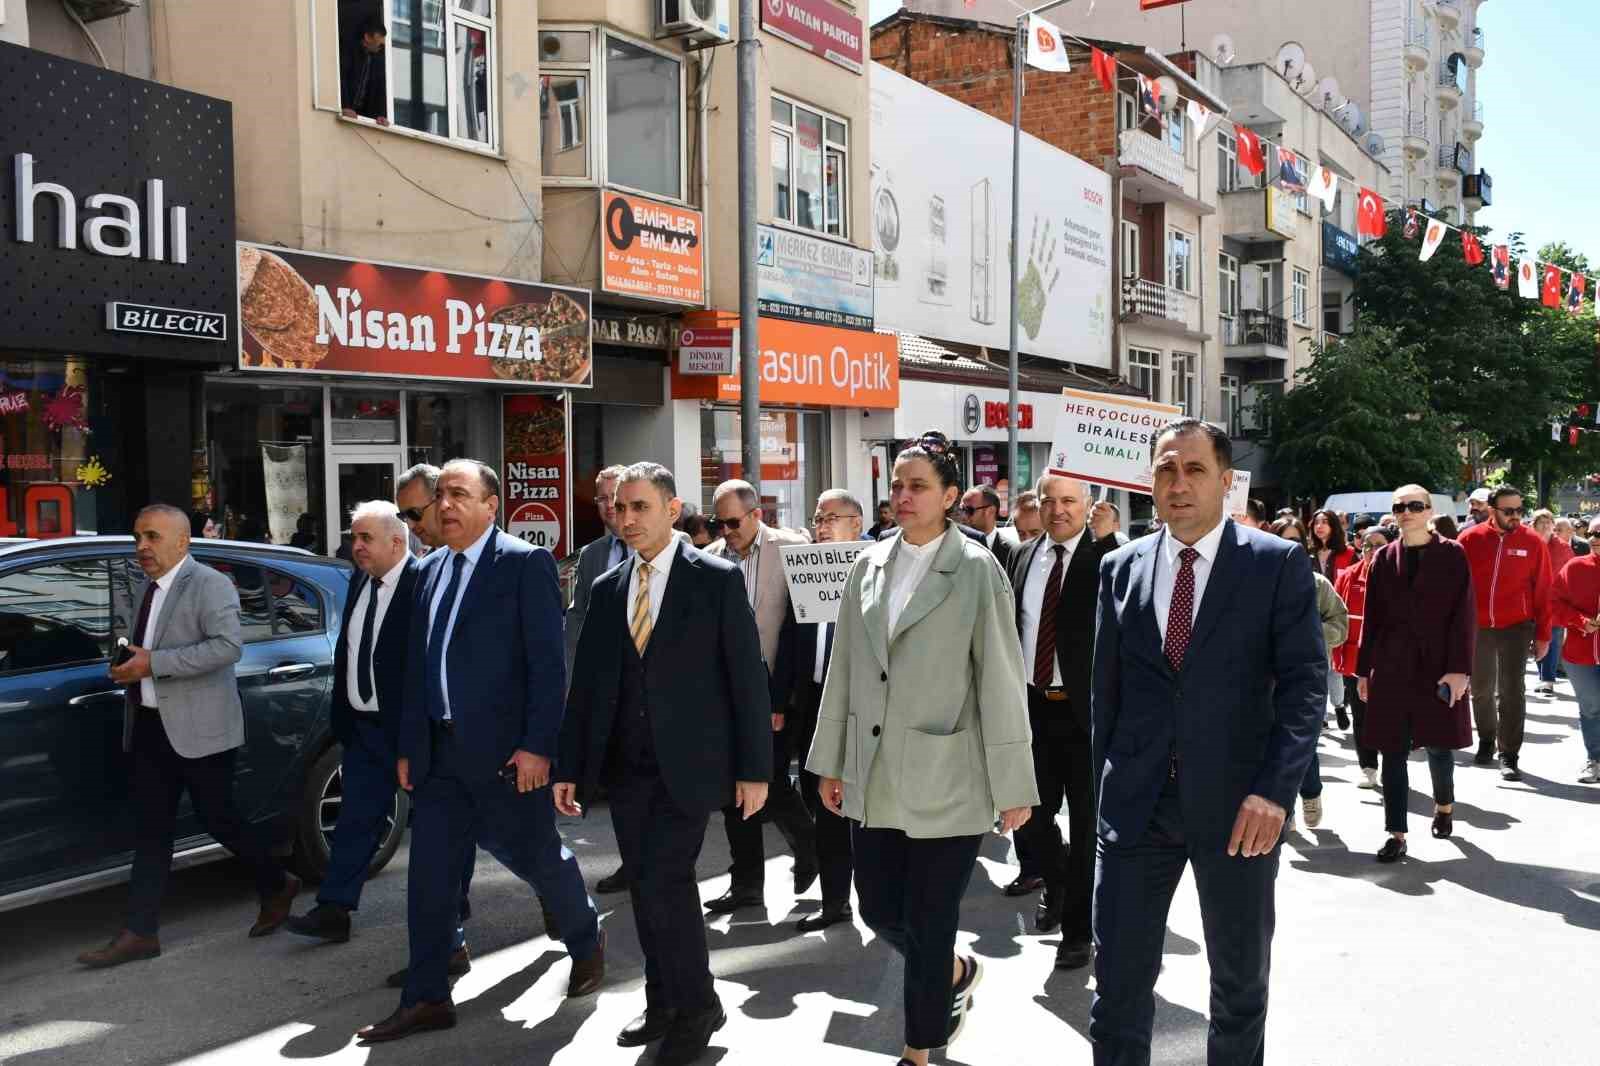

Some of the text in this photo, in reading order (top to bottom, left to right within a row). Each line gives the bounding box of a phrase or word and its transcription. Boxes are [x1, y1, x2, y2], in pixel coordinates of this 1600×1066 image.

[786, 2, 821, 32] VATAN
[14, 152, 188, 264] halı
[632, 206, 697, 237] EMİRLER
[639, 229, 691, 256] EMLAK
[122, 309, 220, 334] BİLECİK
[315, 284, 543, 362] Nisan Pizza
[757, 345, 892, 398] asun Optik
[1083, 442, 1141, 461] OLMALI
[507, 462, 560, 480] Nisan
[509, 482, 560, 500] Pizza
[524, 512, 545, 521] Pizza
[786, 548, 862, 567] HAYDİ BİLEC
[791, 571, 848, 584] KORUYUC
[818, 590, 842, 601] OLA
